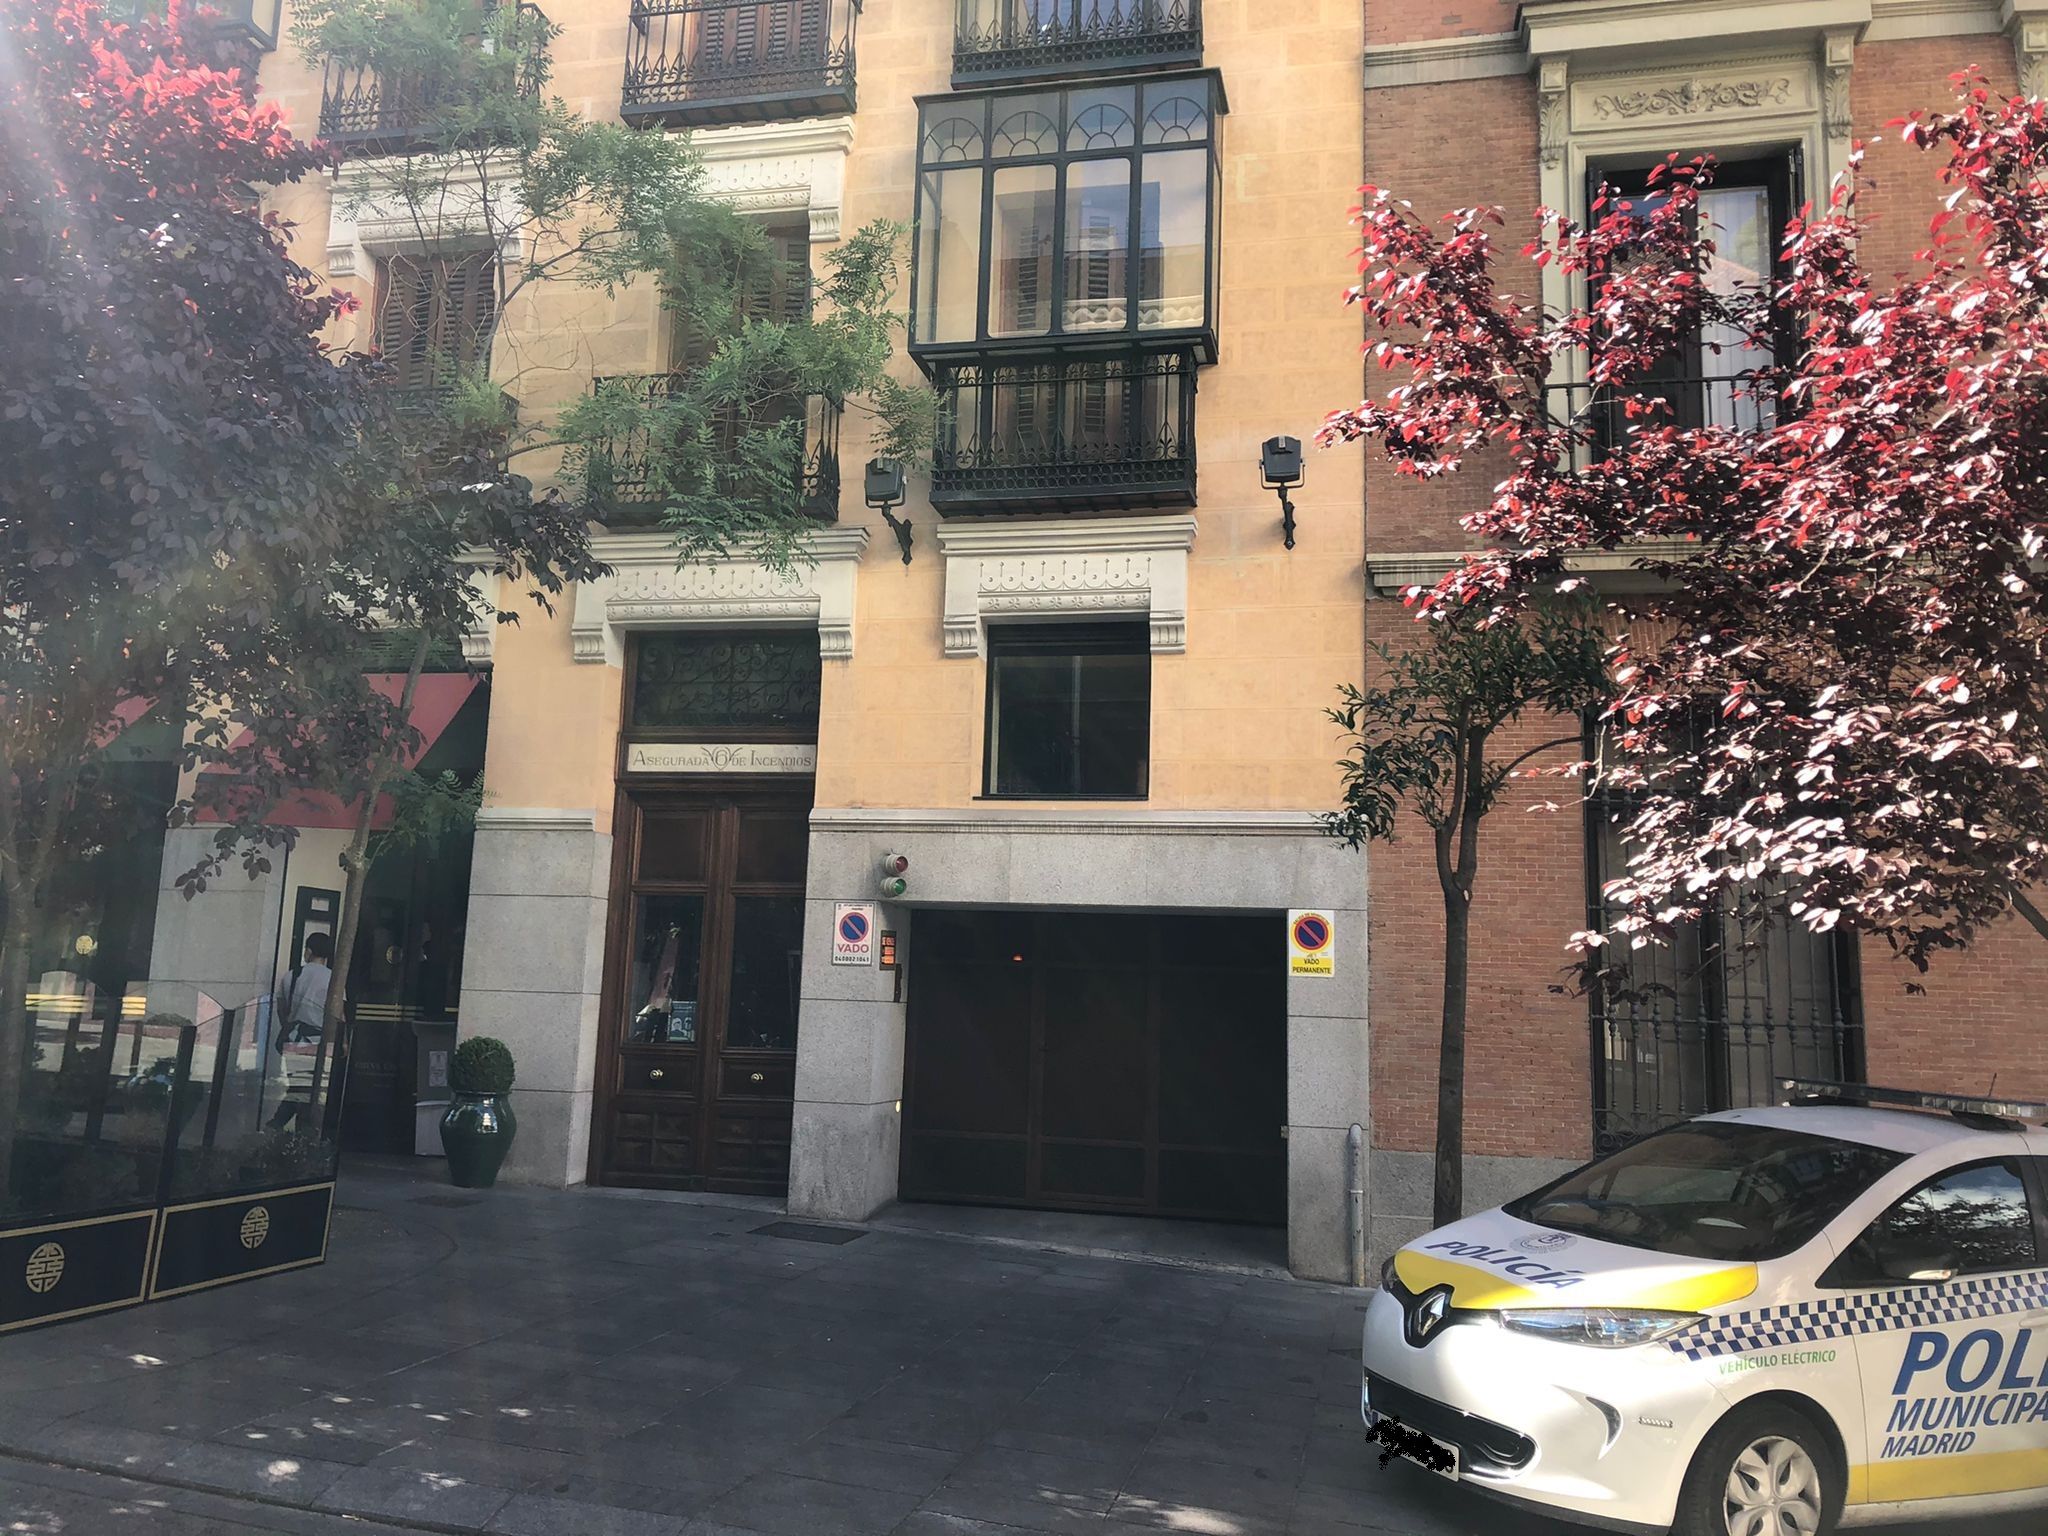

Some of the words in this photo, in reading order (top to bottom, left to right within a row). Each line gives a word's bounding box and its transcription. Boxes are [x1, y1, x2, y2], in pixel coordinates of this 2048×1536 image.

[837, 943, 870, 954] VADO
[1292, 966, 1332, 974] PERMANENTE
[1425, 1240, 1585, 1289] POLICÍA
[1718, 1354, 1779, 1375] VEHÍCULO
[1781, 1348, 1837, 1366] ELÉCTRICO
[1880, 1431, 1976, 1459] MADRID
